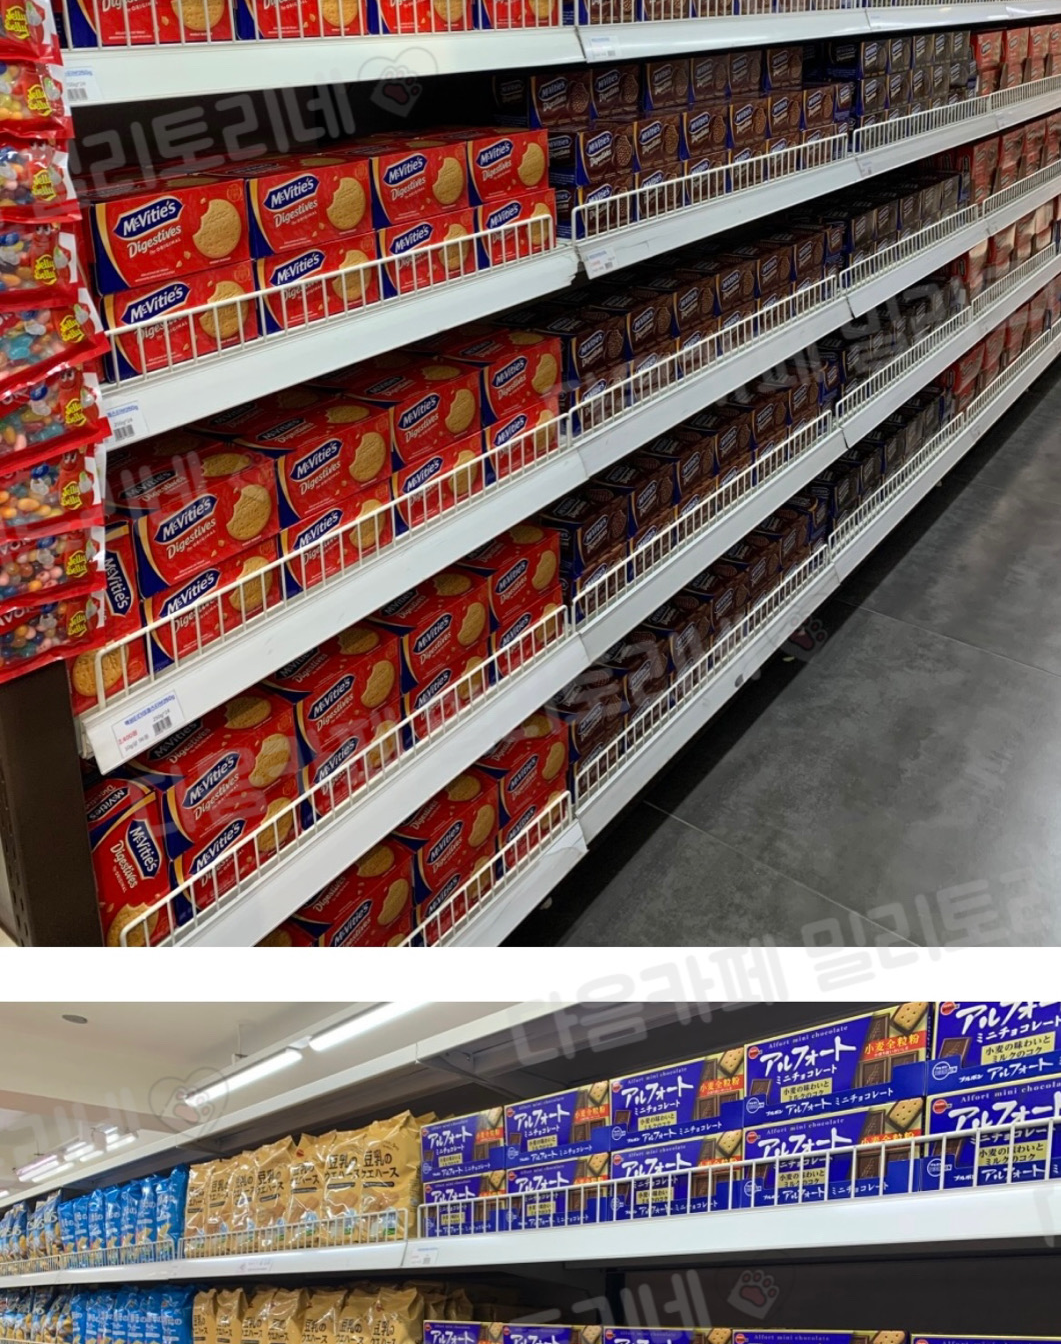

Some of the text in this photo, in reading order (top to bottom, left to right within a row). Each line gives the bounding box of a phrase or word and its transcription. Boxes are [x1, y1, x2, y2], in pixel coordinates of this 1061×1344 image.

[389, 158, 423, 182] McVitie's
[480, 143, 510, 165] McVitie's
[271, 177, 313, 208] McVitie's
[391, 177, 426, 201] Digestives
[123, 200, 176, 236] McVitie's
[274, 200, 318, 228] Digestives
[127, 225, 182, 259] Digestives
[395, 226, 429, 253] McVitie's
[277, 252, 320, 285] McVitie's
[130, 286, 184, 323] McVitie's
[402, 396, 437, 428] McVitie's
[405, 413, 439, 443] Digestives
[297, 442, 338, 478] McVitie's
[300, 460, 341, 496] Digestives
[162, 497, 211, 541] McVitie's
[166, 518, 216, 560] Digestives
[167, 571, 215, 617] McVitie's
[417, 616, 450, 650] McVitie's
[420, 631, 452, 665] Digestives
[313, 676, 351, 717] McVitie's
[316, 694, 354, 732] Digestives
[190, 756, 235, 804] McVitie's
[194, 774, 240, 820] Digestives
[110, 840, 138, 889] Digestives
[130, 826, 157, 872] McVitie's
[811, 1025, 848, 1039] chocolate
[865, 1034, 920, 1054] 小麦全粒粉
[985, 1036, 1051, 1057] 小麦の味わいと
[760, 1036, 857, 1077] アルフォート
[987, 1058, 1053, 1080] アルフォート
[776, 1063, 837, 1085] ミニチョコレート
[622, 1076, 694, 1108] アルフォート
[786, 1087, 894, 1115] アルフォート ミニチョコレート
[961, 1087, 1018, 1103] Alfort mini
[514, 1103, 571, 1129] アルフォート
[364, 1150, 392, 1167] 豆乳の
[304, 1319, 326, 1333] 豆乳の
